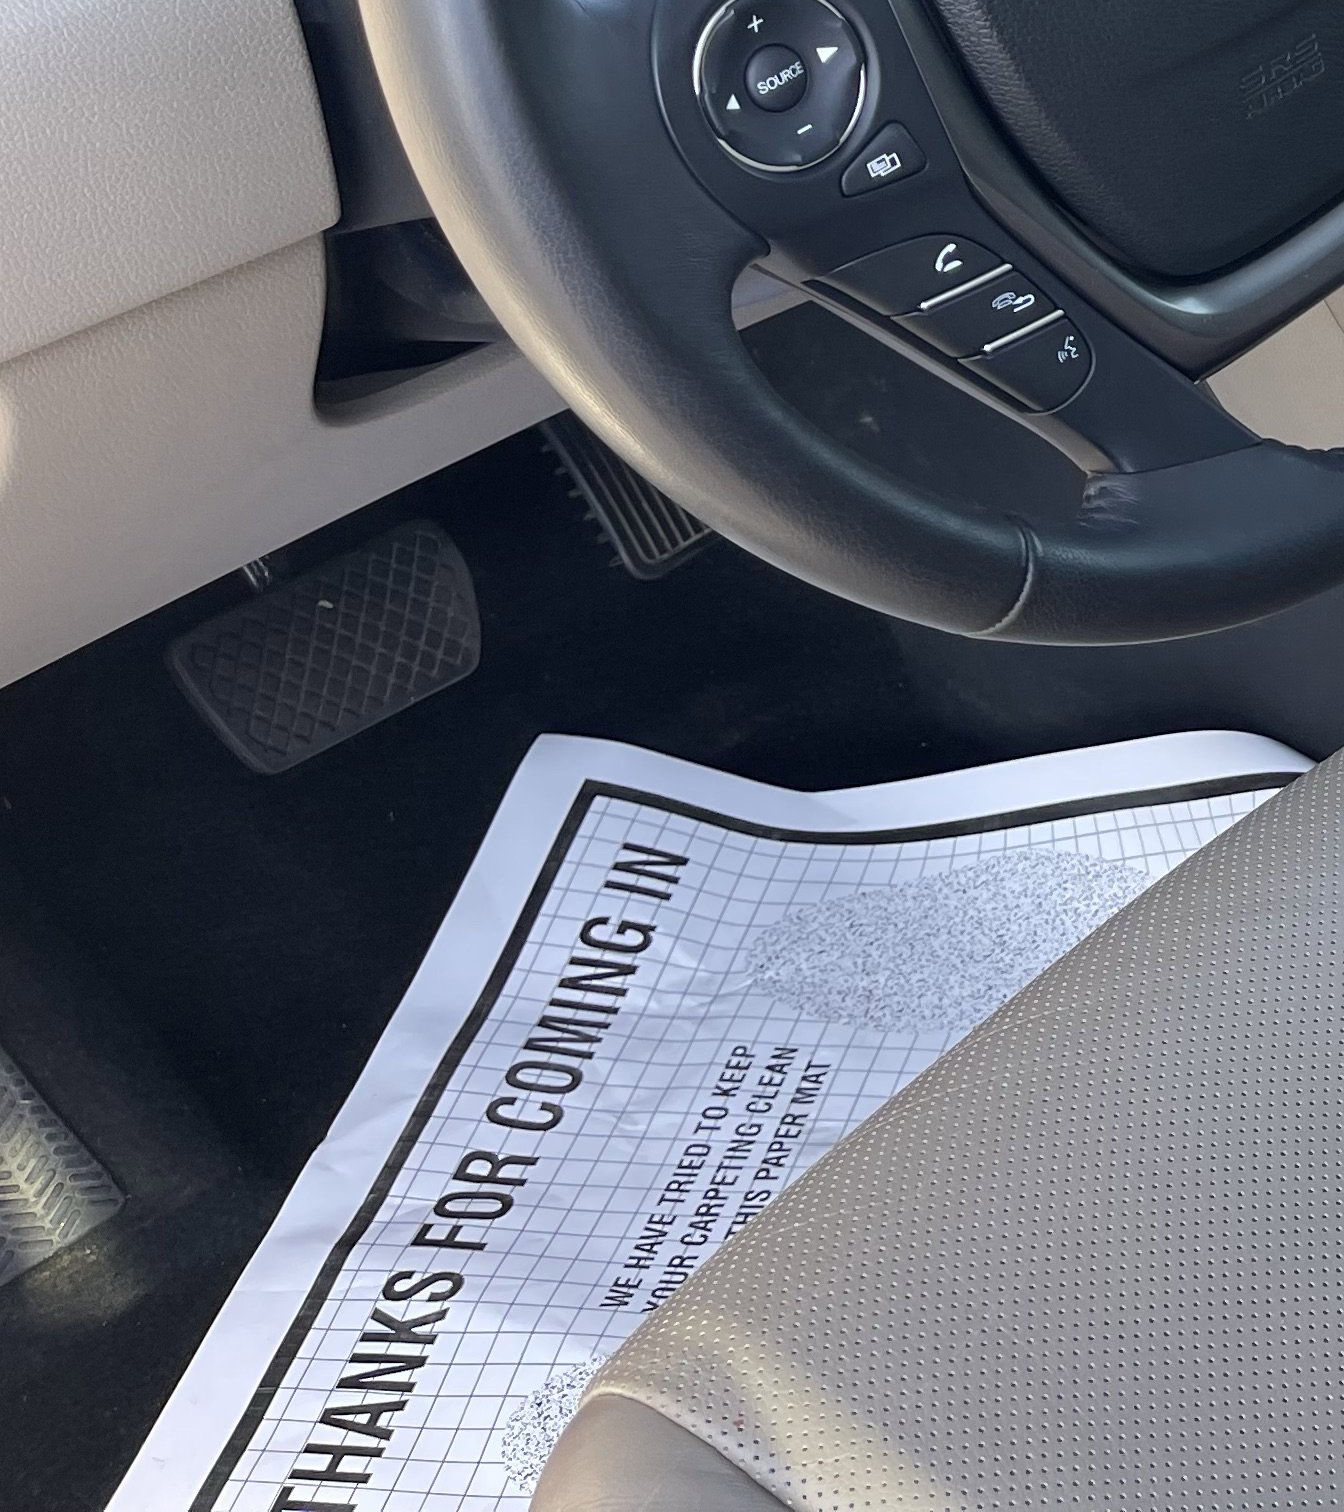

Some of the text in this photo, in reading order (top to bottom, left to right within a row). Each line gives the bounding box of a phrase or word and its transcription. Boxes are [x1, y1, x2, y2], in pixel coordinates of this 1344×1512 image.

[757, 61, 804, 95] SOURCE
[270, 842, 691, 1512] THANKS FOR COMING IN
[600, 1044, 756, 1309] WE HAVE TRIED TO KEEP
[640, 1046, 800, 1315] YOUR CARPETING CLEAN
[753, 1112, 809, 1182] PAPER
[790, 1059, 833, 1105] MAT
